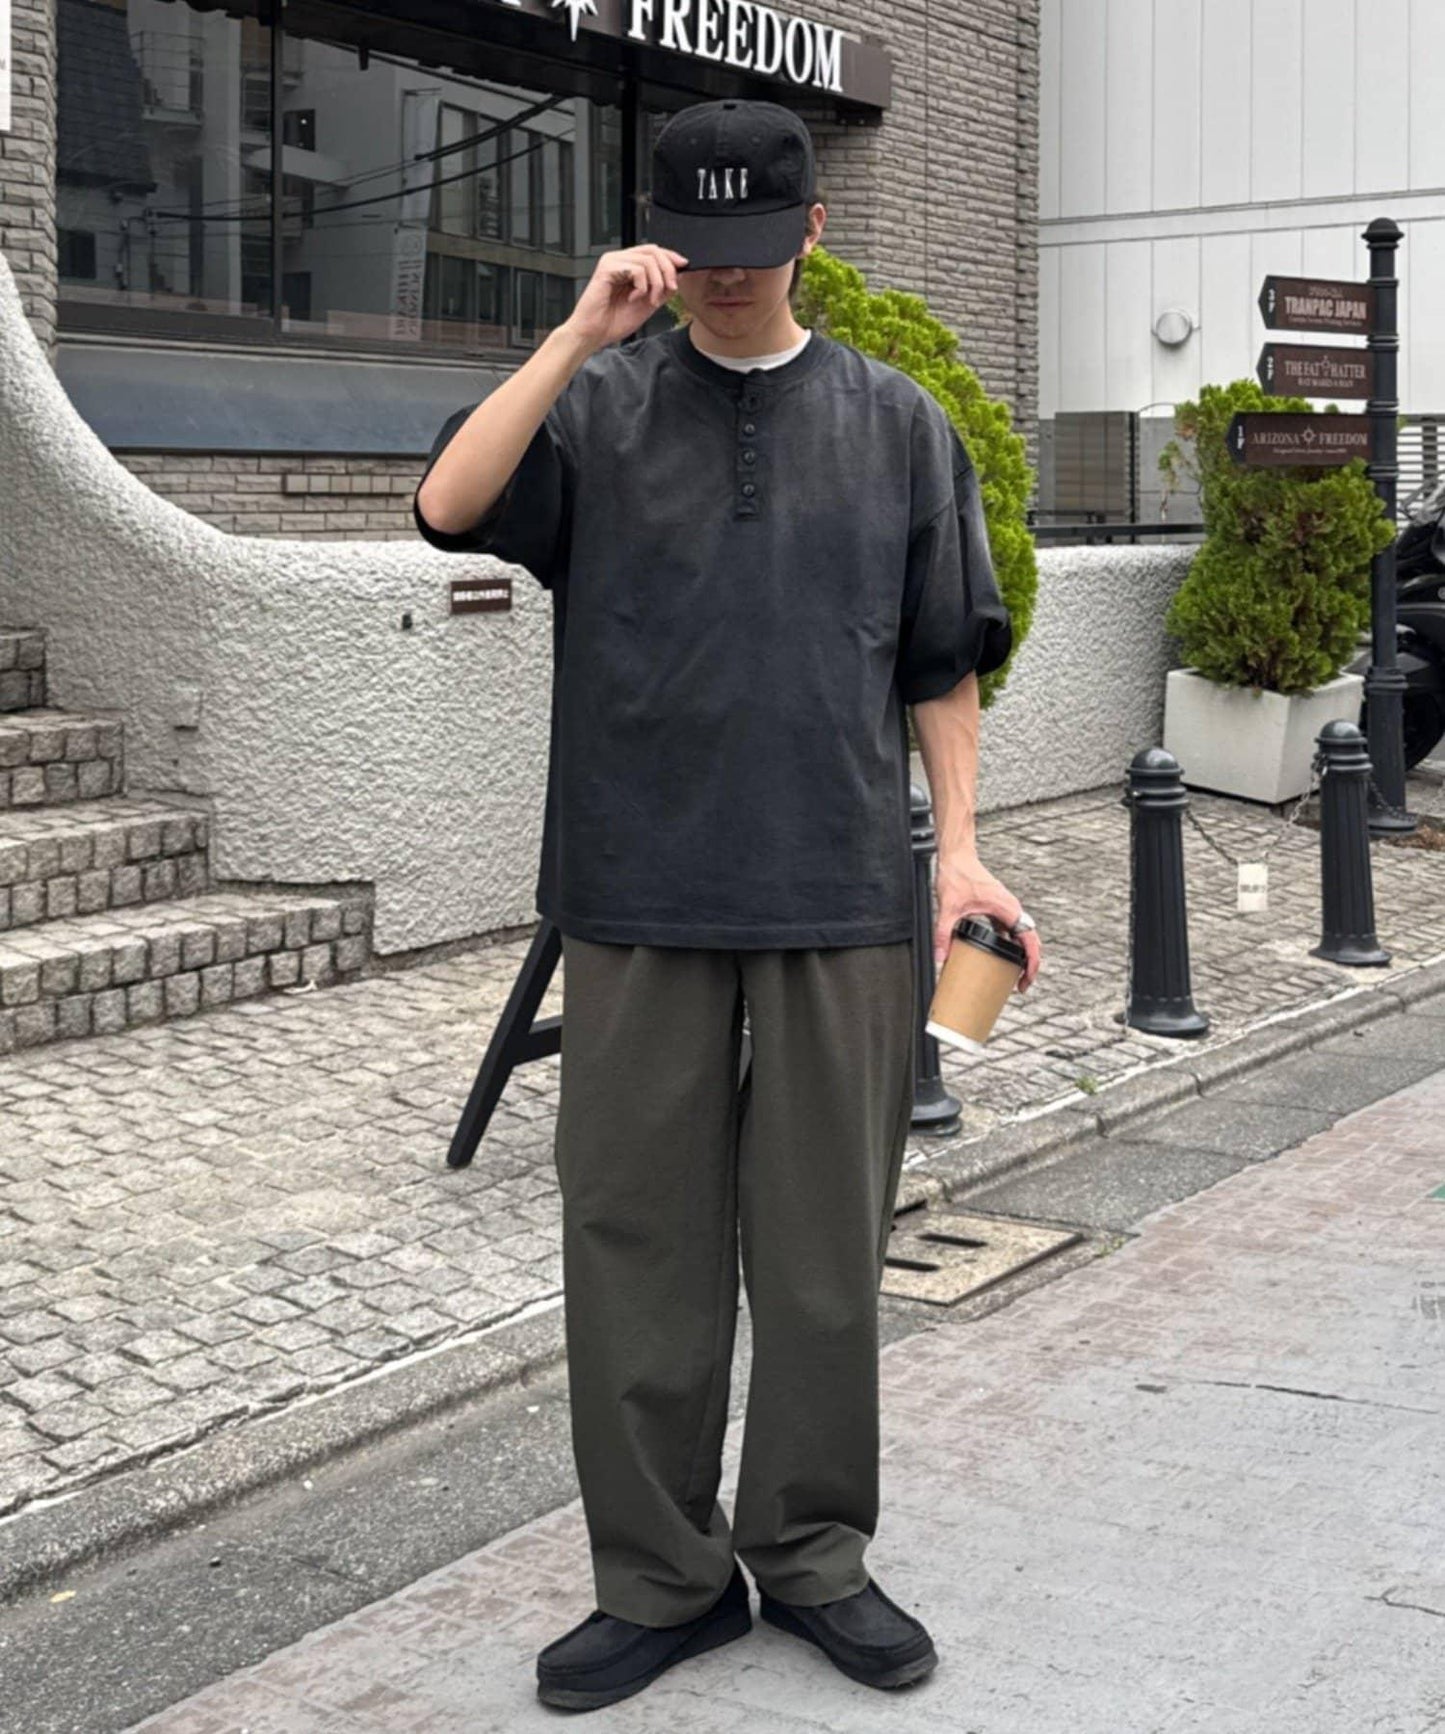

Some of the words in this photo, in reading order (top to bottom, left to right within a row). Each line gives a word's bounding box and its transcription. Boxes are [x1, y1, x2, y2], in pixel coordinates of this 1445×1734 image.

[627, 0, 843, 93] FREEDOM
[697, 167, 749, 200] TAKE
[1336, 301, 1367, 319] JAPAN
[1284, 360, 1302, 377] THE
[1252, 432, 1301, 446] ARIZONA
[1319, 432, 1368, 446] FREEDOM
